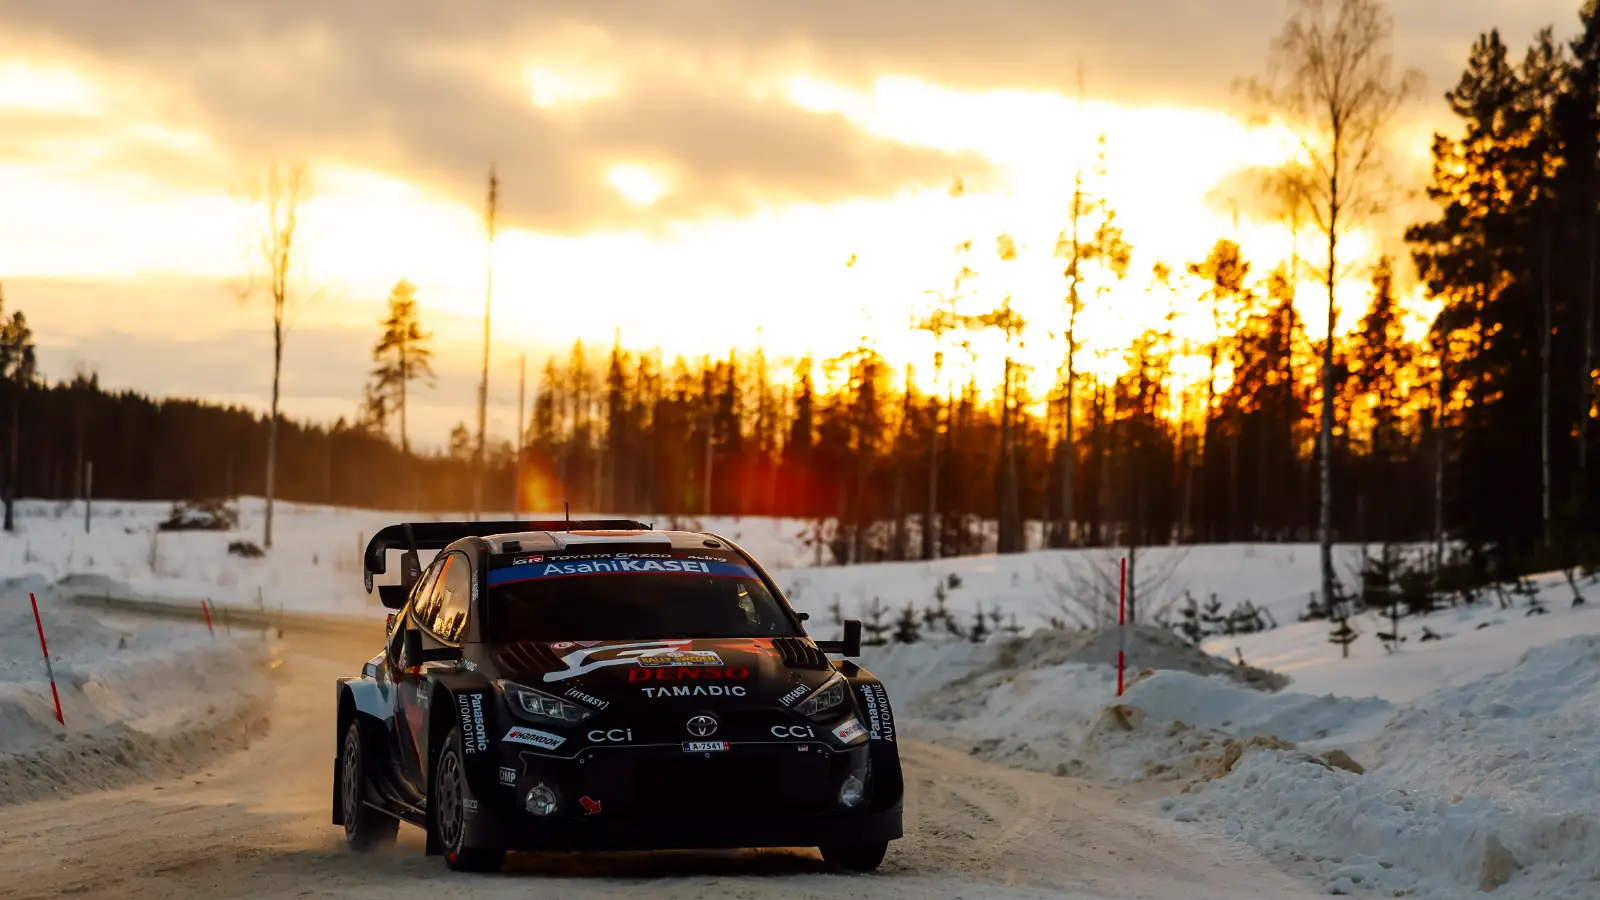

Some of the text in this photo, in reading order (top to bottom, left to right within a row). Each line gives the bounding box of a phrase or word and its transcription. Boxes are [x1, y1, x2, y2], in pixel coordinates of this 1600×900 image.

[515, 555, 543, 565] GR
[547, 553, 610, 561] TOYOTA
[614, 552, 671, 560] GAZOO
[628, 667, 750, 682] DENSO
[641, 685, 747, 698] TAMADIC
[457, 694, 475, 754] AUTOMOTIVE
[470, 693, 490, 752] Panasonic
[860, 684, 882, 741] Panasonic
[872, 684, 893, 742] AUTOMOTIVE
